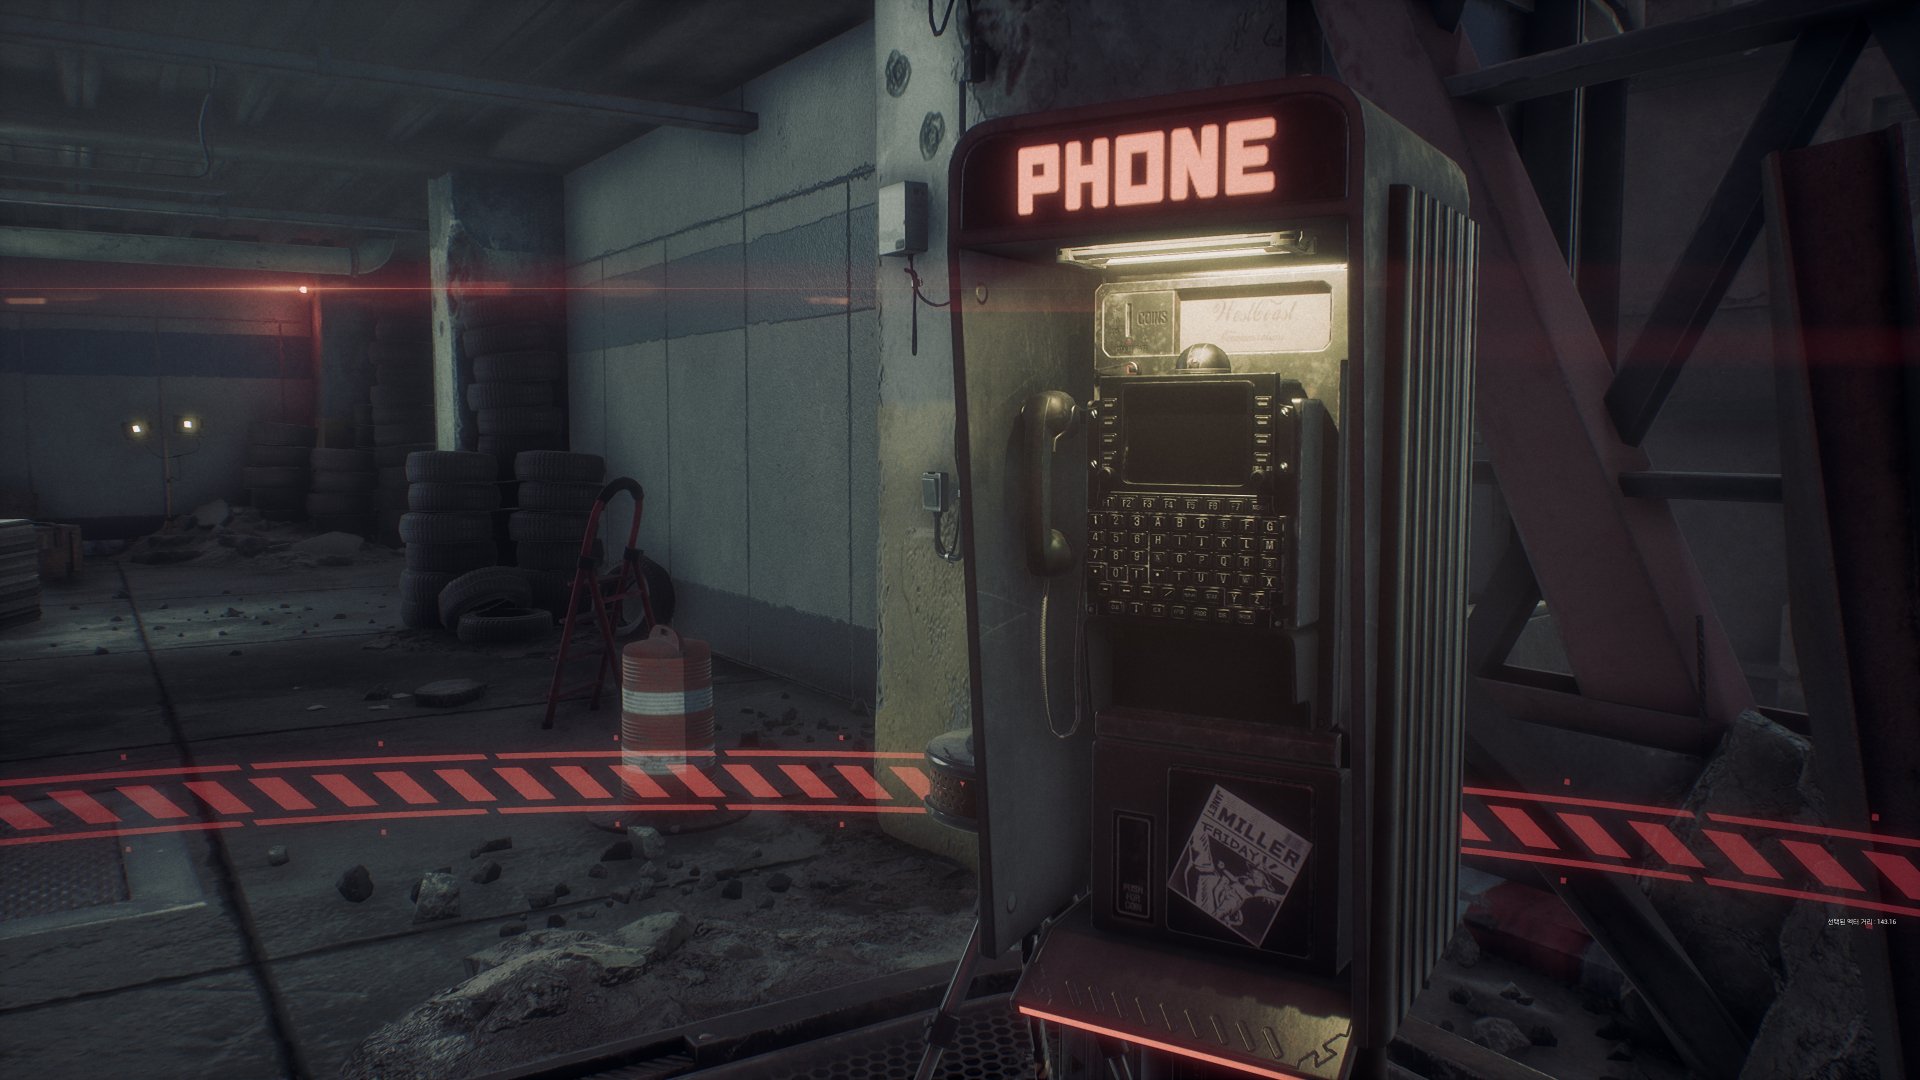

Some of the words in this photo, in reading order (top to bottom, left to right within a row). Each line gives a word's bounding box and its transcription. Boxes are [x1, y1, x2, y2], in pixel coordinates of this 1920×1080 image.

[1018, 116, 1277, 216] PHONE
[1137, 311, 1168, 326] COINS
[1122, 499, 1131, 508] F2
[1143, 500, 1152, 508] F3
[1186, 501, 1195, 509] F5
[1208, 502, 1218, 510] F6
[1094, 515, 1098, 525] 1
[1113, 515, 1119, 525] 2
[1134, 516, 1140, 526] 3
[1155, 517, 1161, 526] A
[1176, 518, 1183, 528] B
[1198, 519, 1205, 529] C
[1244, 520, 1250, 530] F
[1266, 521, 1273, 531] G
[1092, 532, 1098, 541] 4
[1113, 534, 1119, 543] 5
[1134, 534, 1140, 544] 6
[1155, 535, 1161, 544] H
[1221, 538, 1227, 547] K
[1244, 539, 1249, 549] L
[1265, 540, 1274, 550] M
[1093, 550, 1098, 559] 7
[1113, 551, 1119, 560] 8
[1134, 551, 1140, 561] 9
[1199, 556, 1205, 564] P
[1220, 556, 1227, 566] Q
[1243, 557, 1249, 567] R
[1177, 572, 1182, 580] T
[1198, 573, 1204, 582] U
[1220, 574, 1226, 583] V
[1266, 577, 1272, 587] X
[1231, 594, 1237, 603] Y
[1254, 595, 1260, 604] Z
[1207, 790, 1224, 817] JANET
[1201, 821, 1259, 861] FRIDAY
[1217, 807, 1301, 868] MILLER
